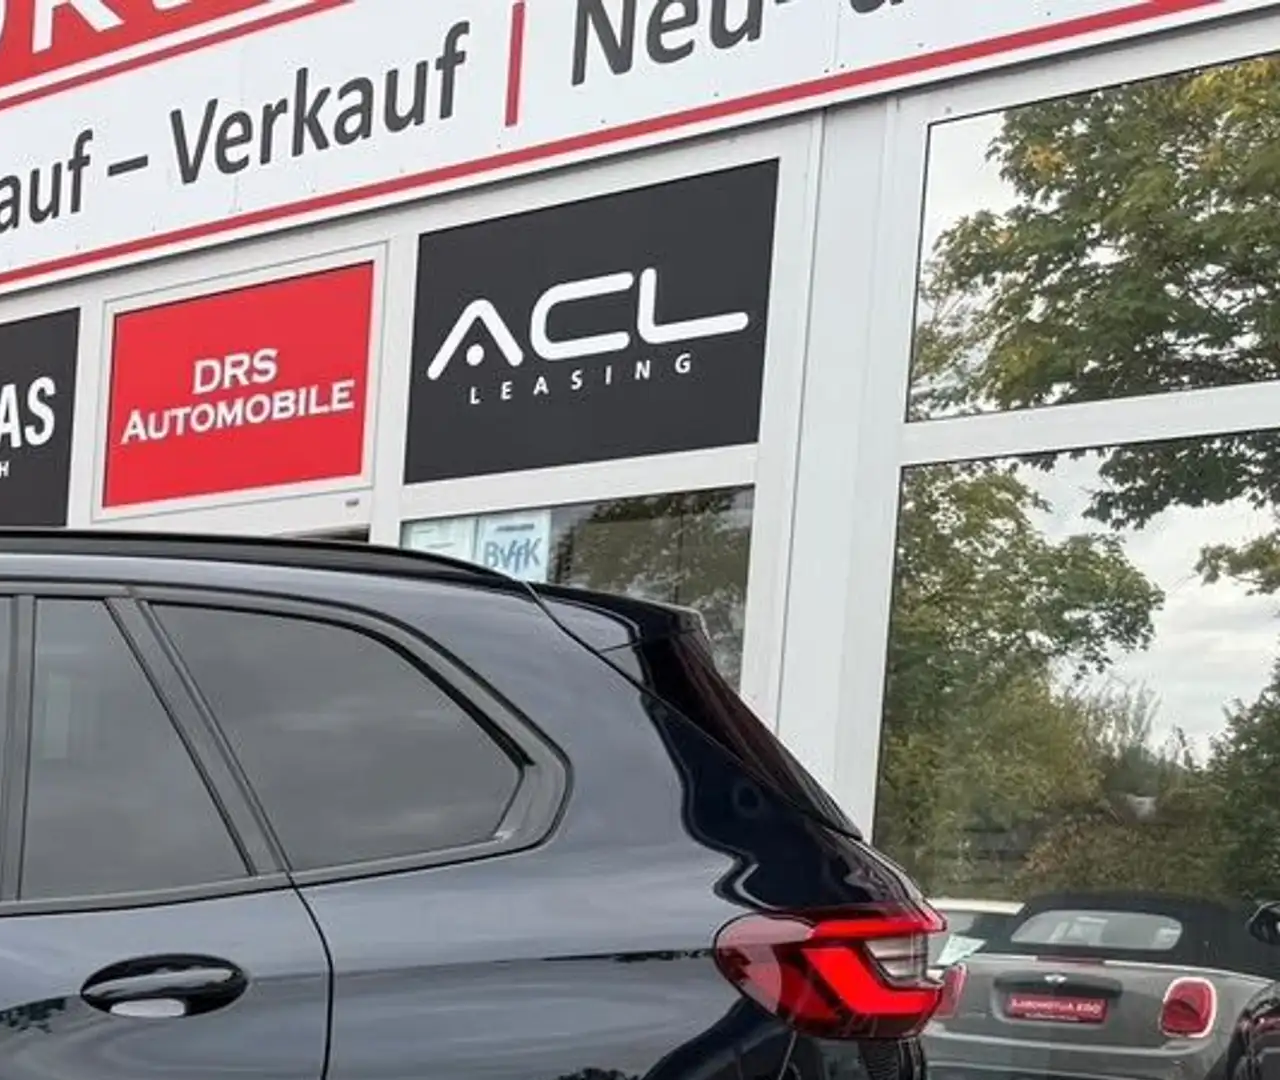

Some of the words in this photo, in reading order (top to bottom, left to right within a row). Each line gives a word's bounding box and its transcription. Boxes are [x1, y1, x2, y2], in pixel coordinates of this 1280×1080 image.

[169, 20, 470, 185] Verkauf
[427, 267, 749, 381] ACL
[191, 348, 279, 395] DRS
[469, 353, 691, 405] LEASING
[120, 379, 356, 445] AUTOMOBILE
